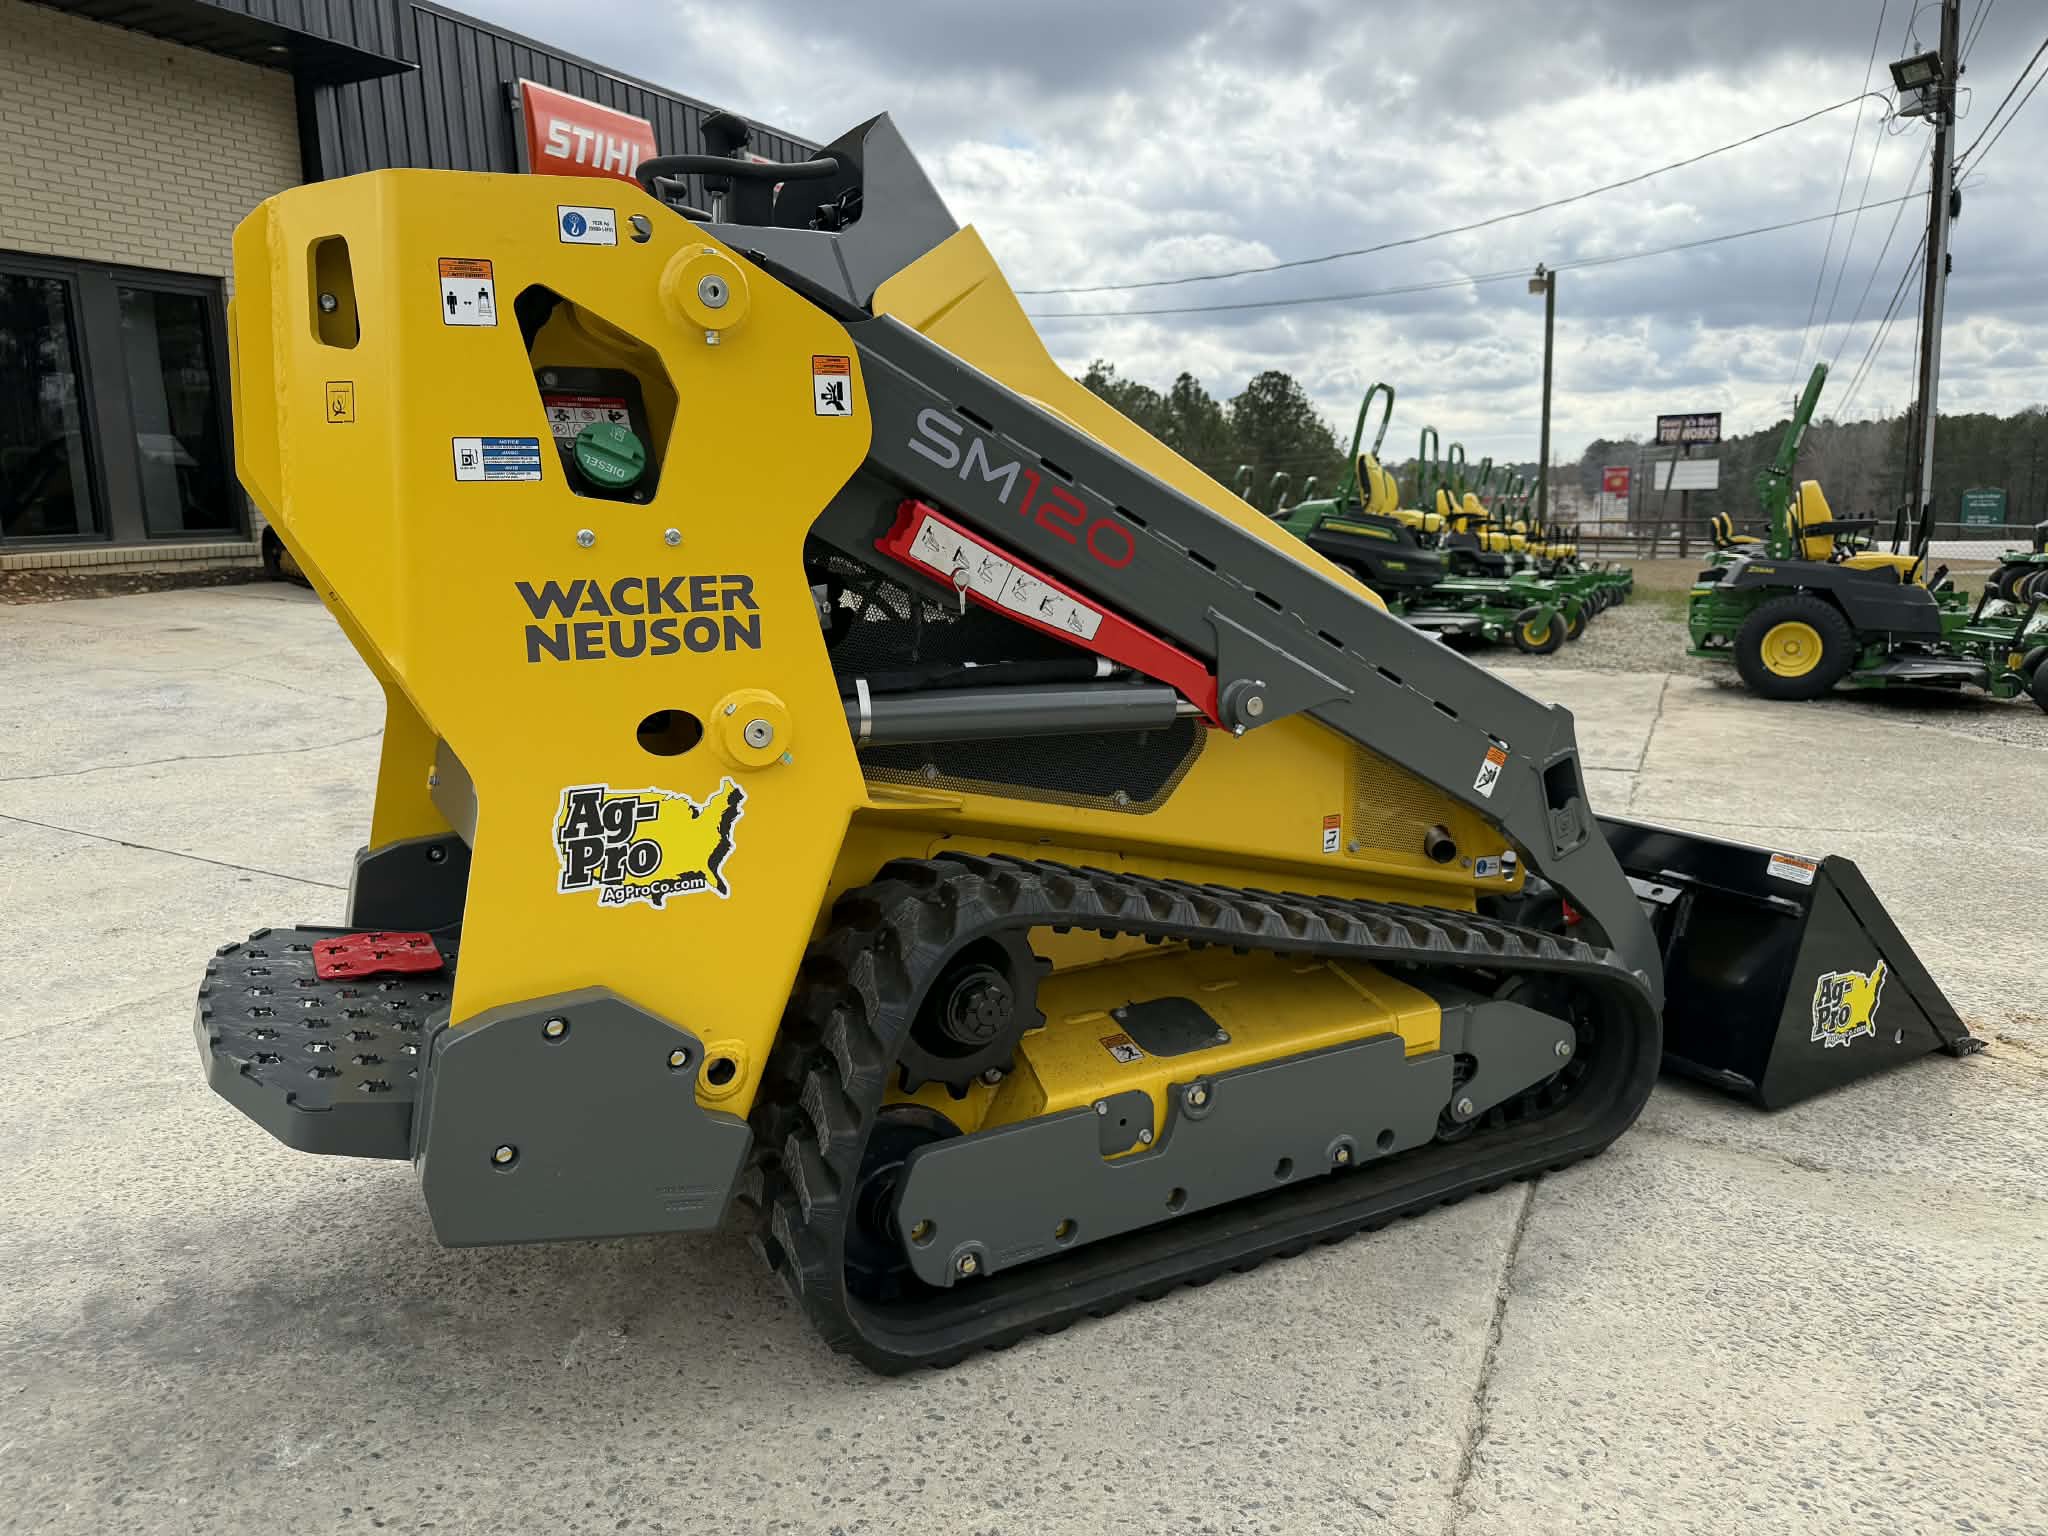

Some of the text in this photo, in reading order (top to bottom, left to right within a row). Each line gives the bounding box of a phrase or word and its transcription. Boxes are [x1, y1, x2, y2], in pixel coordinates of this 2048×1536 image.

[544, 119, 640, 179] STIHL
[583, 454, 625, 478] DIESEL
[908, 408, 1136, 570] SM120
[514, 574, 760, 619] WACKER
[525, 614, 762, 663] NEUSON
[560, 788, 659, 843] Ag-
[562, 836, 663, 888] Pro
[602, 877, 706, 903] AgProCo.com
[1812, 1003, 1851, 1038] Pro
